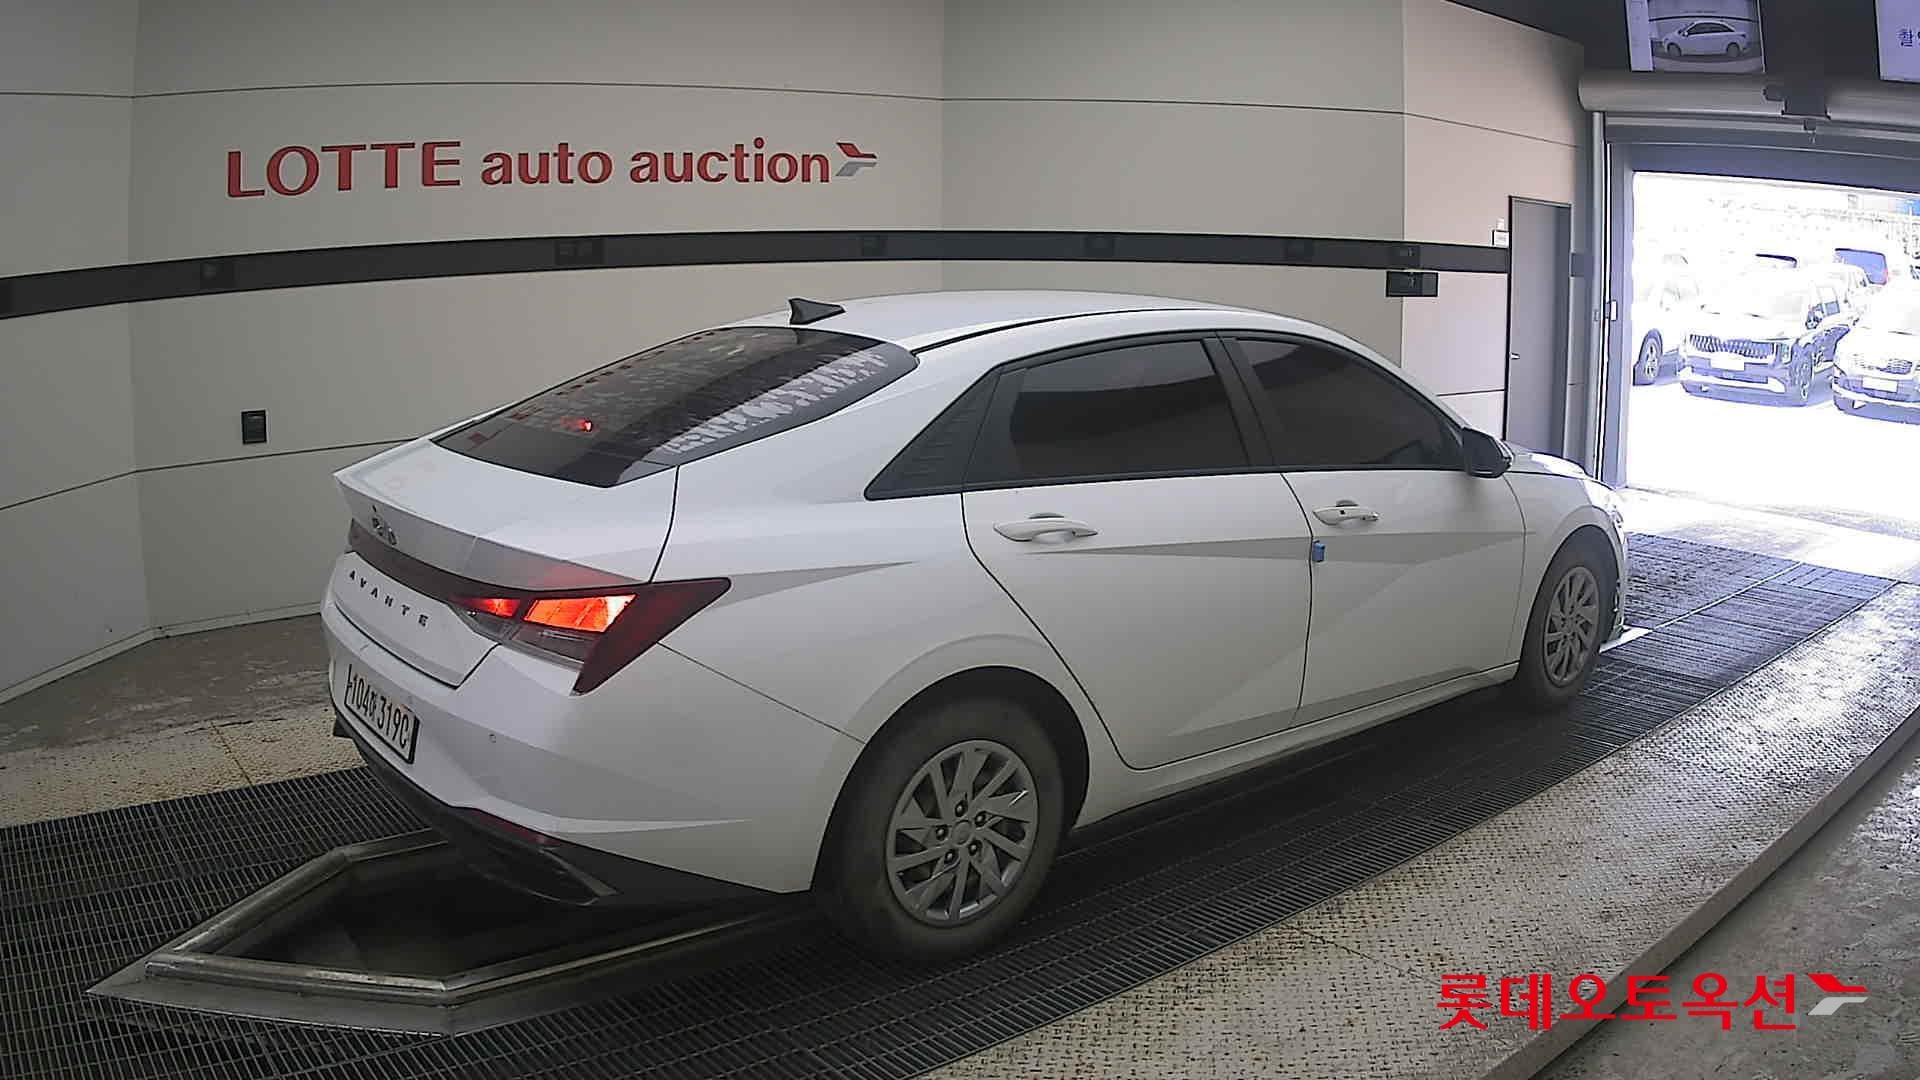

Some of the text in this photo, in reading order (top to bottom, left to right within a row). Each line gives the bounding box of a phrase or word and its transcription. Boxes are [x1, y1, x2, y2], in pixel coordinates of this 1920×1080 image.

[226, 137, 830, 198] LOTTE auto auction
[349, 569, 429, 627] AVANTE
